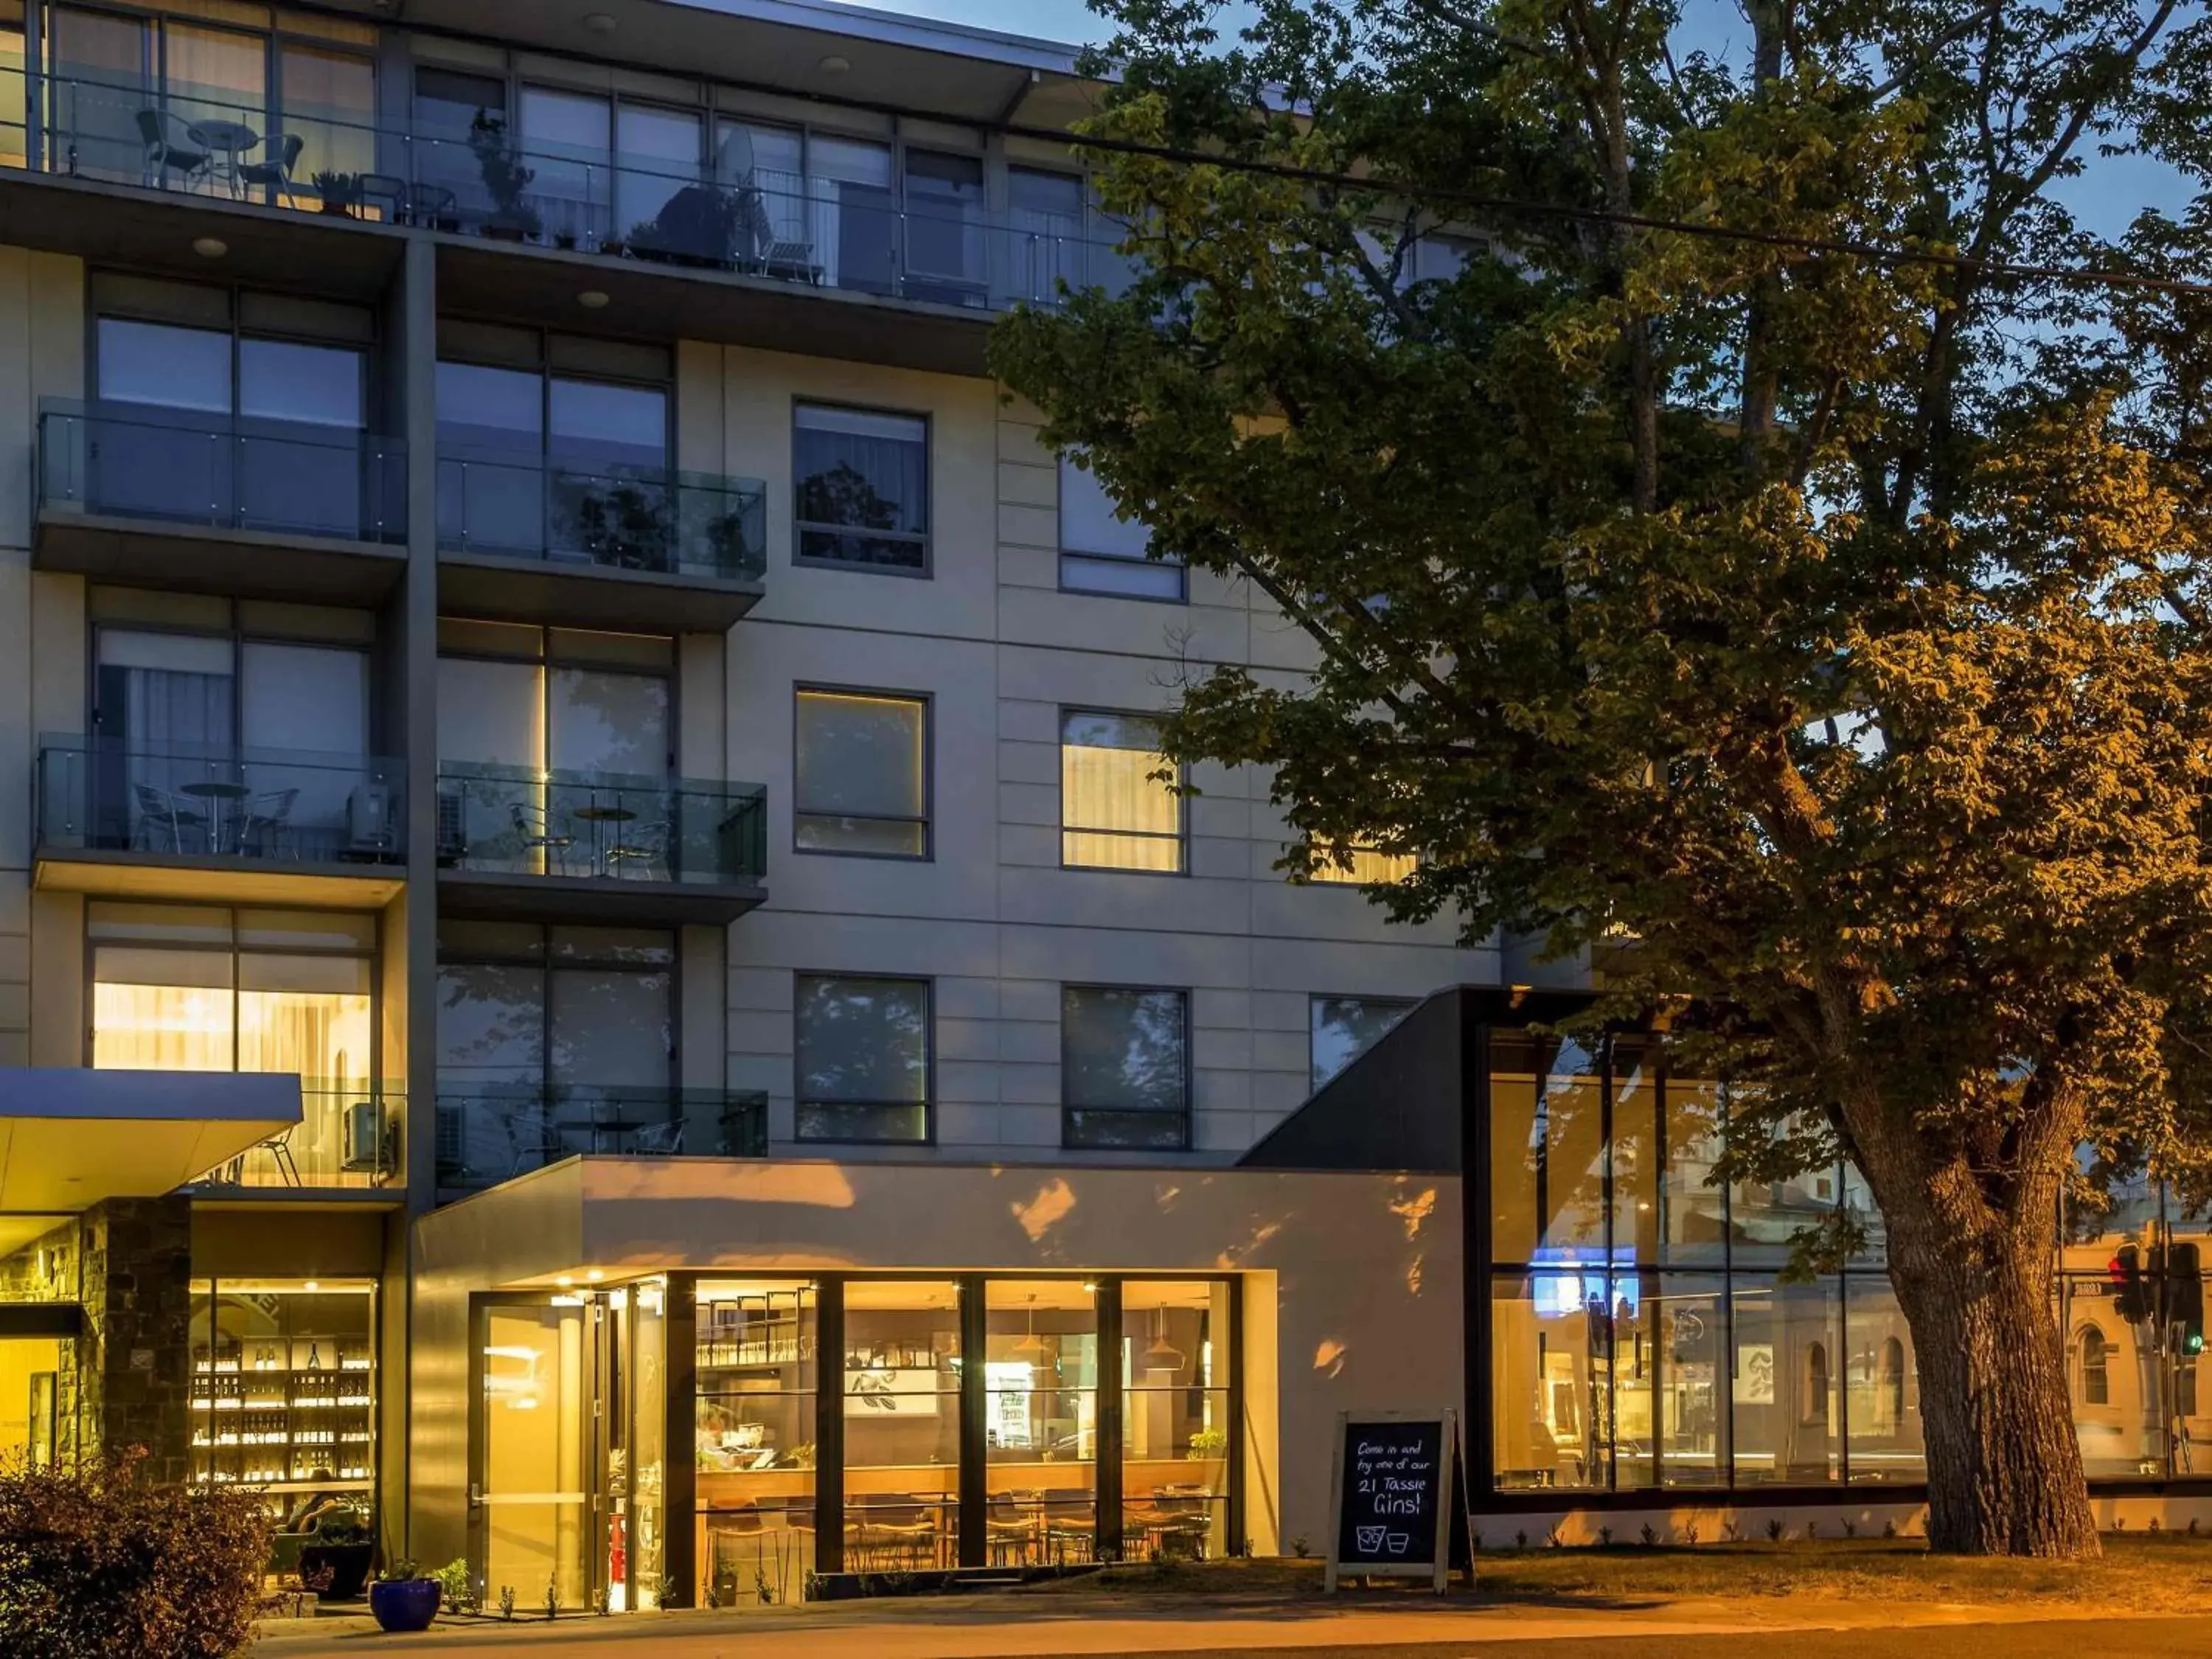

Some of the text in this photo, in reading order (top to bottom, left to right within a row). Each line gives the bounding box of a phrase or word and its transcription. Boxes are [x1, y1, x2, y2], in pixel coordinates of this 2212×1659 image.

[1357, 1439, 1422, 1455] Come in and
[1357, 1458, 1372, 1475] try
[1375, 1461, 1394, 1469] one
[1396, 1458, 1409, 1470] of
[1358, 1477, 1426, 1493] 21 Tassie
[1374, 1492, 1420, 1515] Gins!
